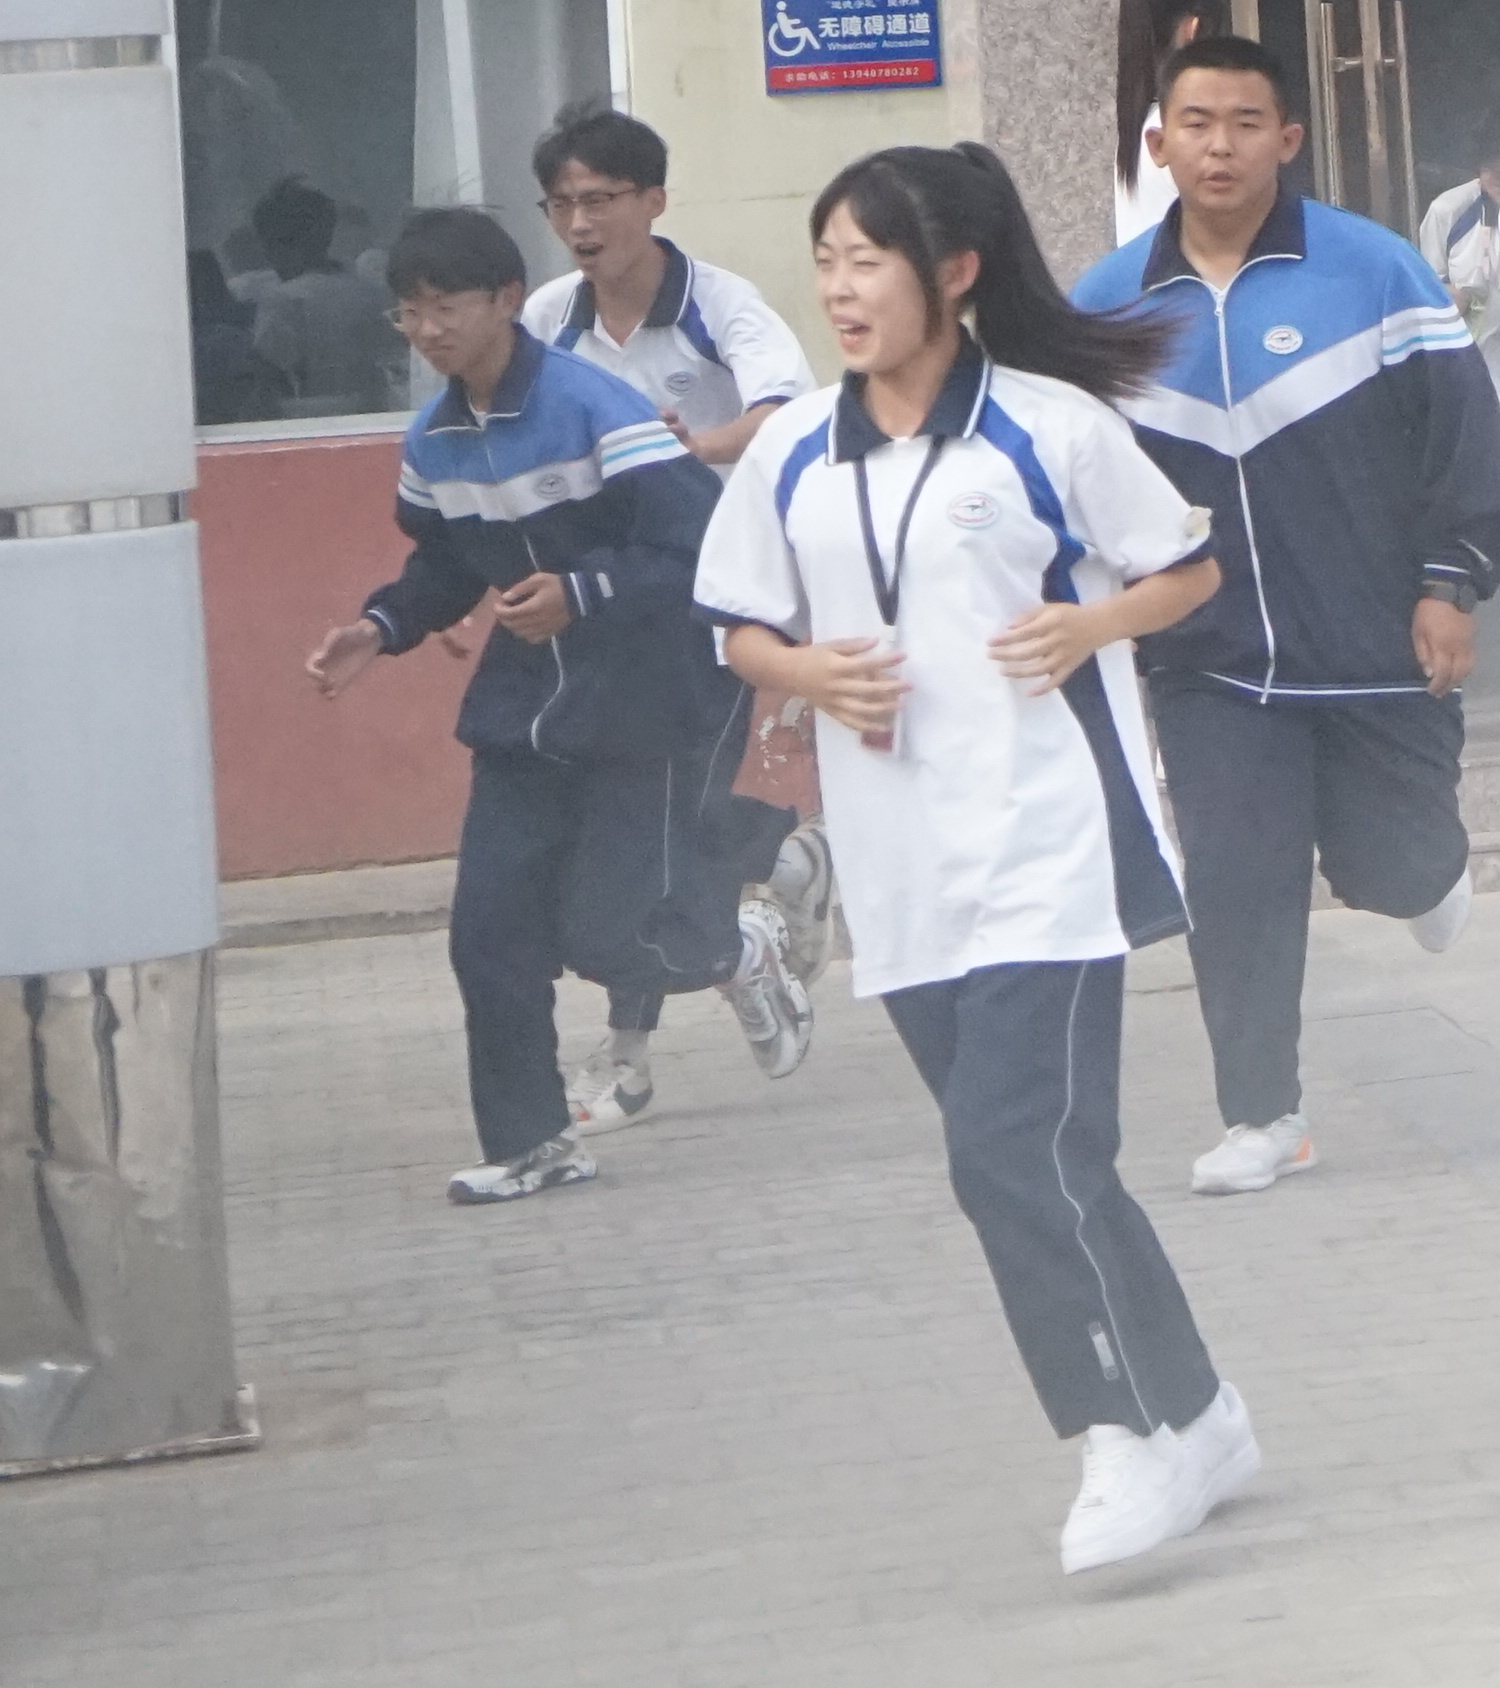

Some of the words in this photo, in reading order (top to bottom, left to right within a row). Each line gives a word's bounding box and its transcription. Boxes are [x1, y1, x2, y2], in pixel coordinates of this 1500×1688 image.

[818, 12, 930, 38] 无障碍通道
